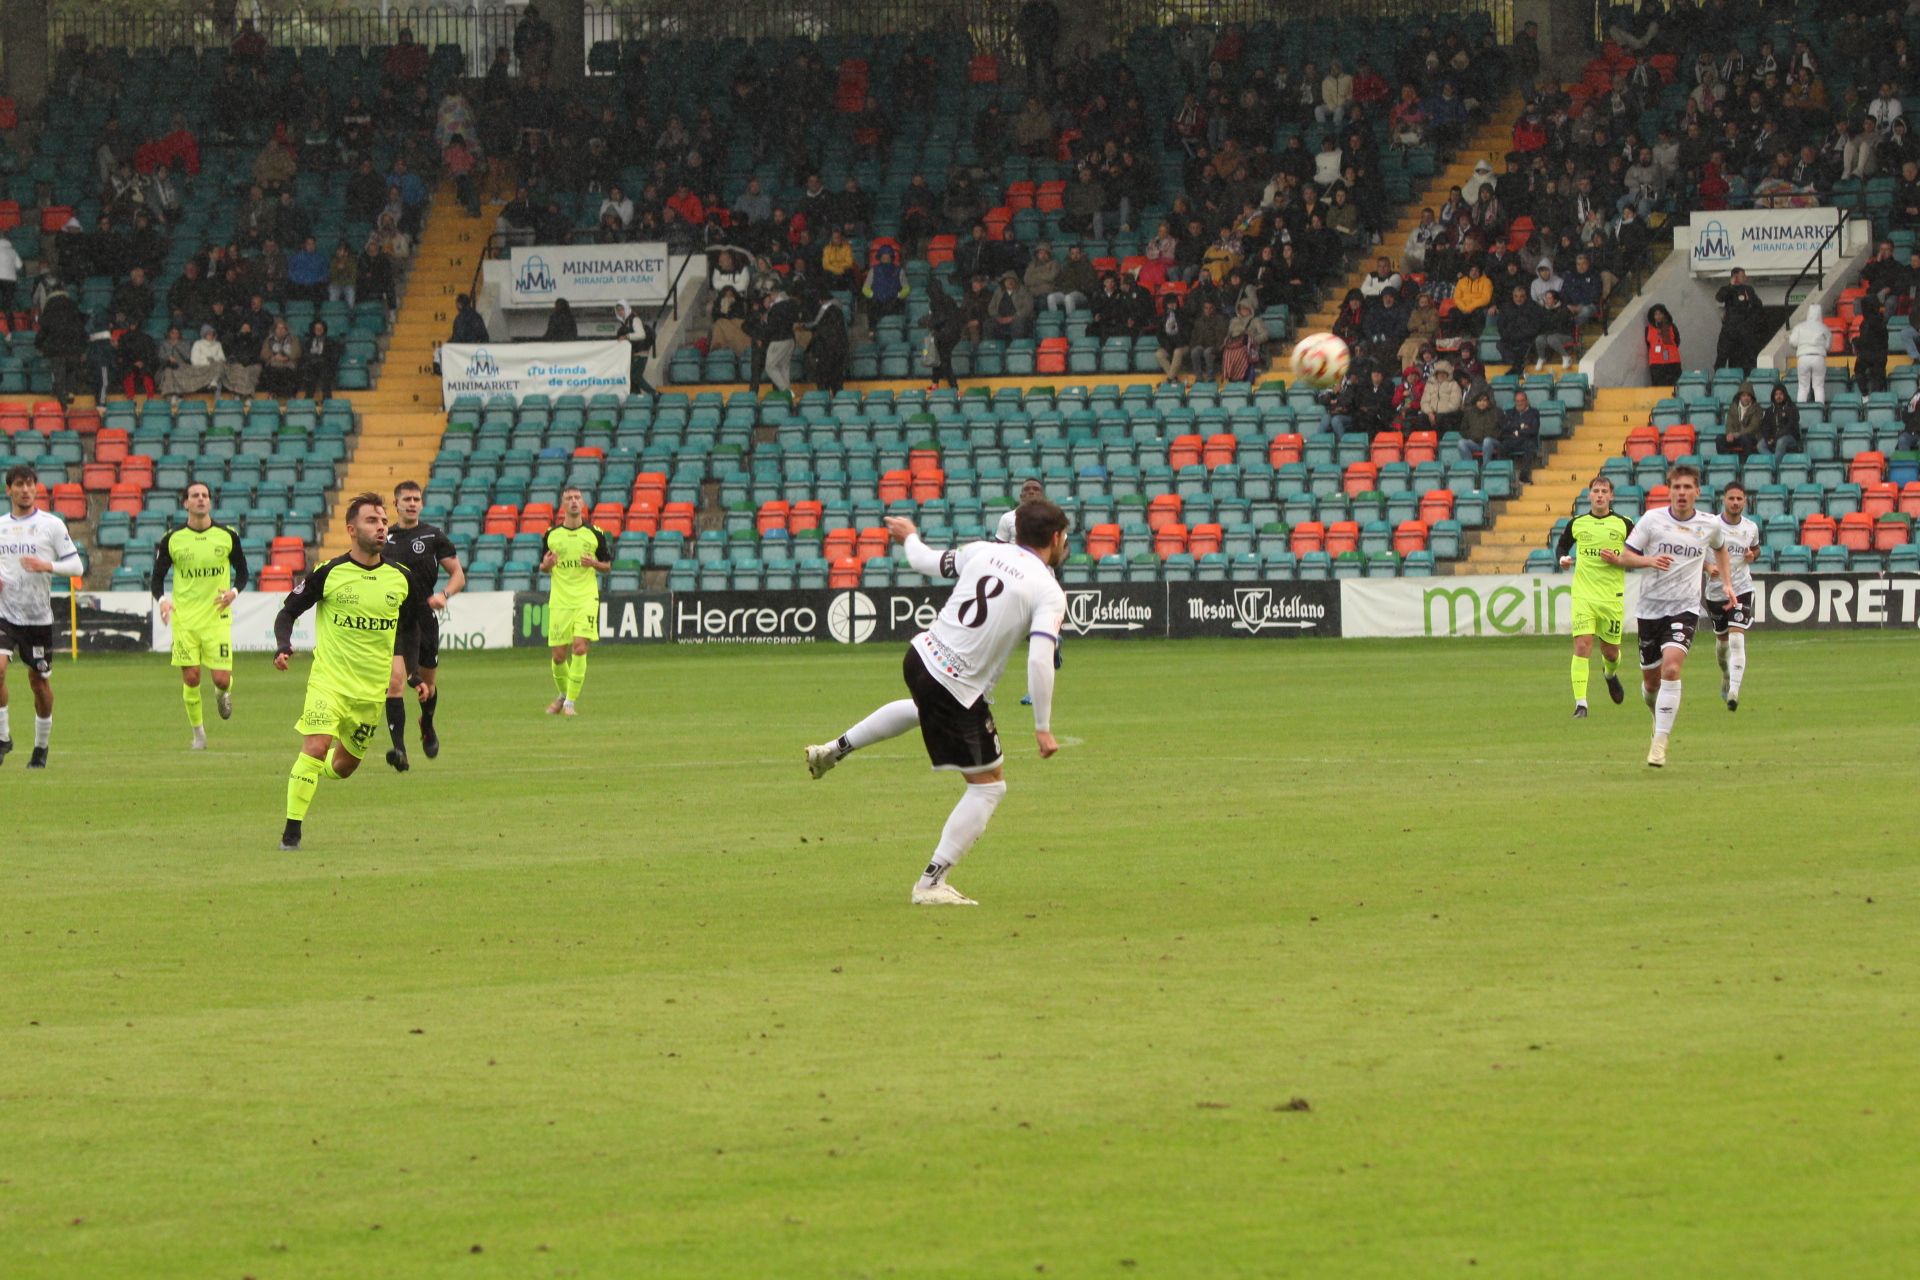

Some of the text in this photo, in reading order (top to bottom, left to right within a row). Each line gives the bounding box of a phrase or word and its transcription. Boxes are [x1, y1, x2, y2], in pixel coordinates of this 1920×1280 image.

[1752, 242, 1794, 252] MIRANDA
[1796, 242, 1808, 250] DE
[562, 259, 664, 275] MINIMARKET
[573, 275, 614, 285] MIRANDA
[616, 275, 628, 284] DE
[527, 363, 587, 377] ¡Tu tienda
[447, 380, 520, 392] MINIMARKET
[548, 376, 627, 388] de confianza!
[1657, 541, 1703, 558] meins
[1727, 542, 1745, 554] ein
[180, 566, 225, 579] LAREDO
[336, 592, 360, 602] Grupo
[957, 575, 1005, 629] 8
[1752, 579, 1920, 624] ORET
[890, 597, 938, 630] Pé
[1071, 592, 1152, 625] Castellano
[1187, 591, 1326, 625] Mesón Castellano
[1423, 578, 1572, 637] mein
[599, 602, 664, 638] LAR
[677, 600, 817, 634] Herrero
